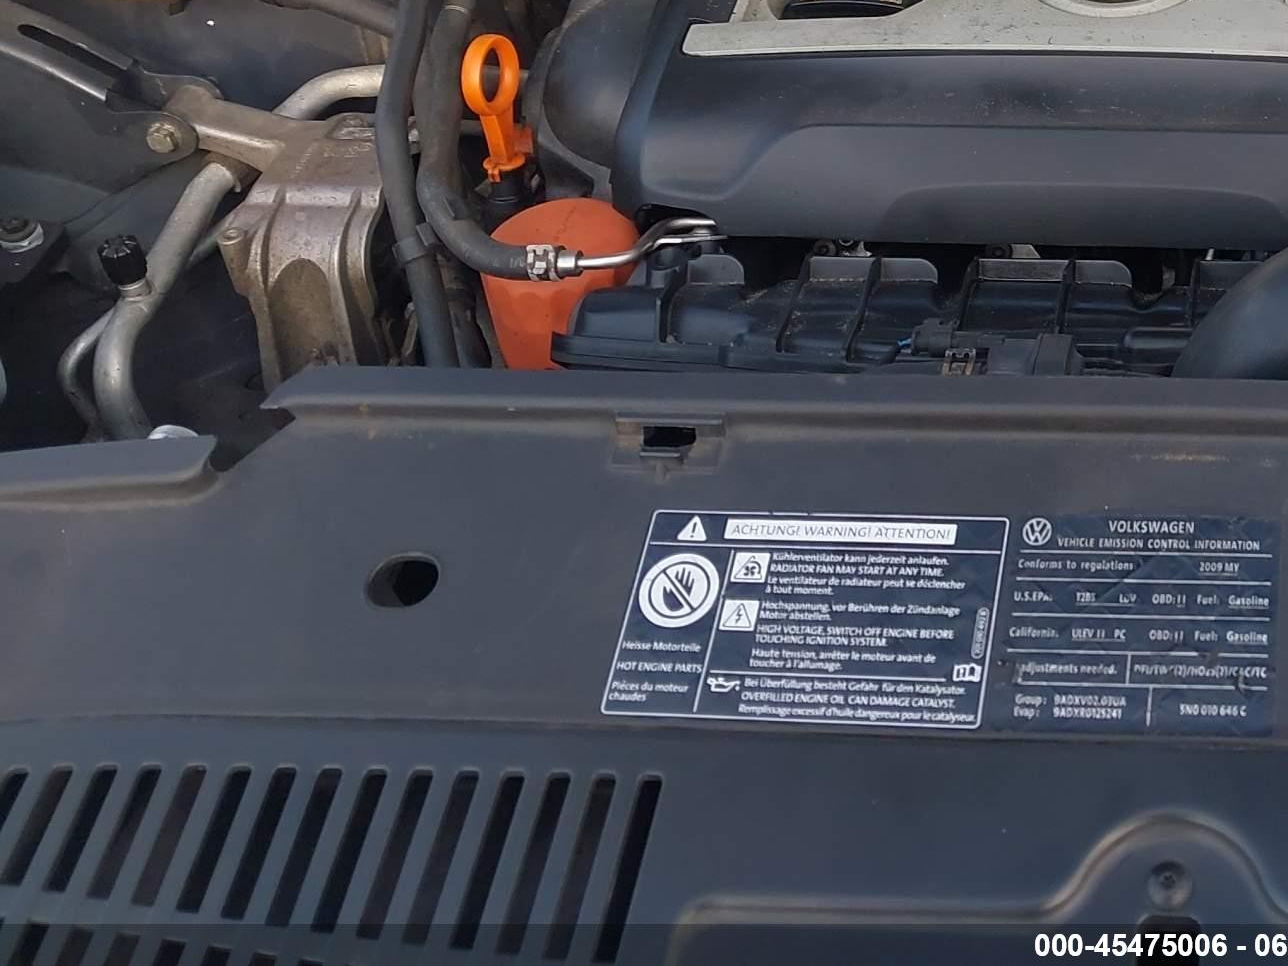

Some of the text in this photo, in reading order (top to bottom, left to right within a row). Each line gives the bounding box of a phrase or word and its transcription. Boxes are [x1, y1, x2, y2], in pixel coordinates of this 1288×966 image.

[732, 523, 950, 539] ACHTUNG! WARNING! ATTENTION!
[1108, 520, 1195, 533] VOLKSWAGEN
[1057, 537, 1260, 550] VEHICLE EMISSION CONTROL INFORMATION
[773, 552, 843, 562] Kühlerventilator
[845, 553, 866, 562] kann
[868, 554, 906, 564] jederzeit
[1018, 558, 1062, 568] Conforms
[1081, 559, 1134, 570] regulations
[770, 563, 814, 573] RADIATOR
[816, 564, 834, 573] FAN
[836, 564, 857, 573] MAY
[858, 565, 884, 574] START
[899, 566, 919, 575] ANY
[1199, 561, 1239, 572] 2009 MY
[780, 575, 827, 585] ventilateur
[842, 577, 882, 586] radiateur
[773, 585, 793, 593] tout
[1228, 595, 1269, 605] Gasoline
[848, 602, 889, 612] Berühren
[907, 604, 960, 616] Zündanlage
[758, 610, 788, 621] Motor
[757, 624, 781, 633] HIGH
[827, 626, 862, 636] SWITCH
[864, 626, 881, 636] OFF
[883, 627, 918, 637] ENGINE
[919, 628, 955, 639] BEFORE
[1226, 630, 1269, 642] Gasoline
[755, 633, 805, 643] TOUCHING
[806, 635, 848, 645] IGNITION
[623, 640, 701, 651] Heisse Motorteile
[751, 648, 780, 657] Haute
[861, 652, 895, 661] moteur
[897, 653, 922, 662] avant
[617, 660, 702, 672] HOT ENGINE PARTS
[749, 658, 784, 667] toucher
[655, 683, 688, 692] moteur
[744, 677, 759, 687] Bei
[814, 680, 847, 690] besteht
[848, 681, 879, 691] Gefahr
[897, 683, 913, 692] den
[609, 691, 647, 701] chaudes
[741, 691, 793, 702] OVERFILLED
[795, 693, 828, 703] ENGINE
[830, 694, 845, 704] OIL
[848, 695, 868, 704] CAN
[870, 695, 910, 706] DAMAGE
[738, 703, 791, 716] Remplissage
[792, 705, 825, 715] excessif
[826, 706, 854, 717] d'huile
[854, 709, 900, 721] dangereux
[901, 711, 921, 721] pour
